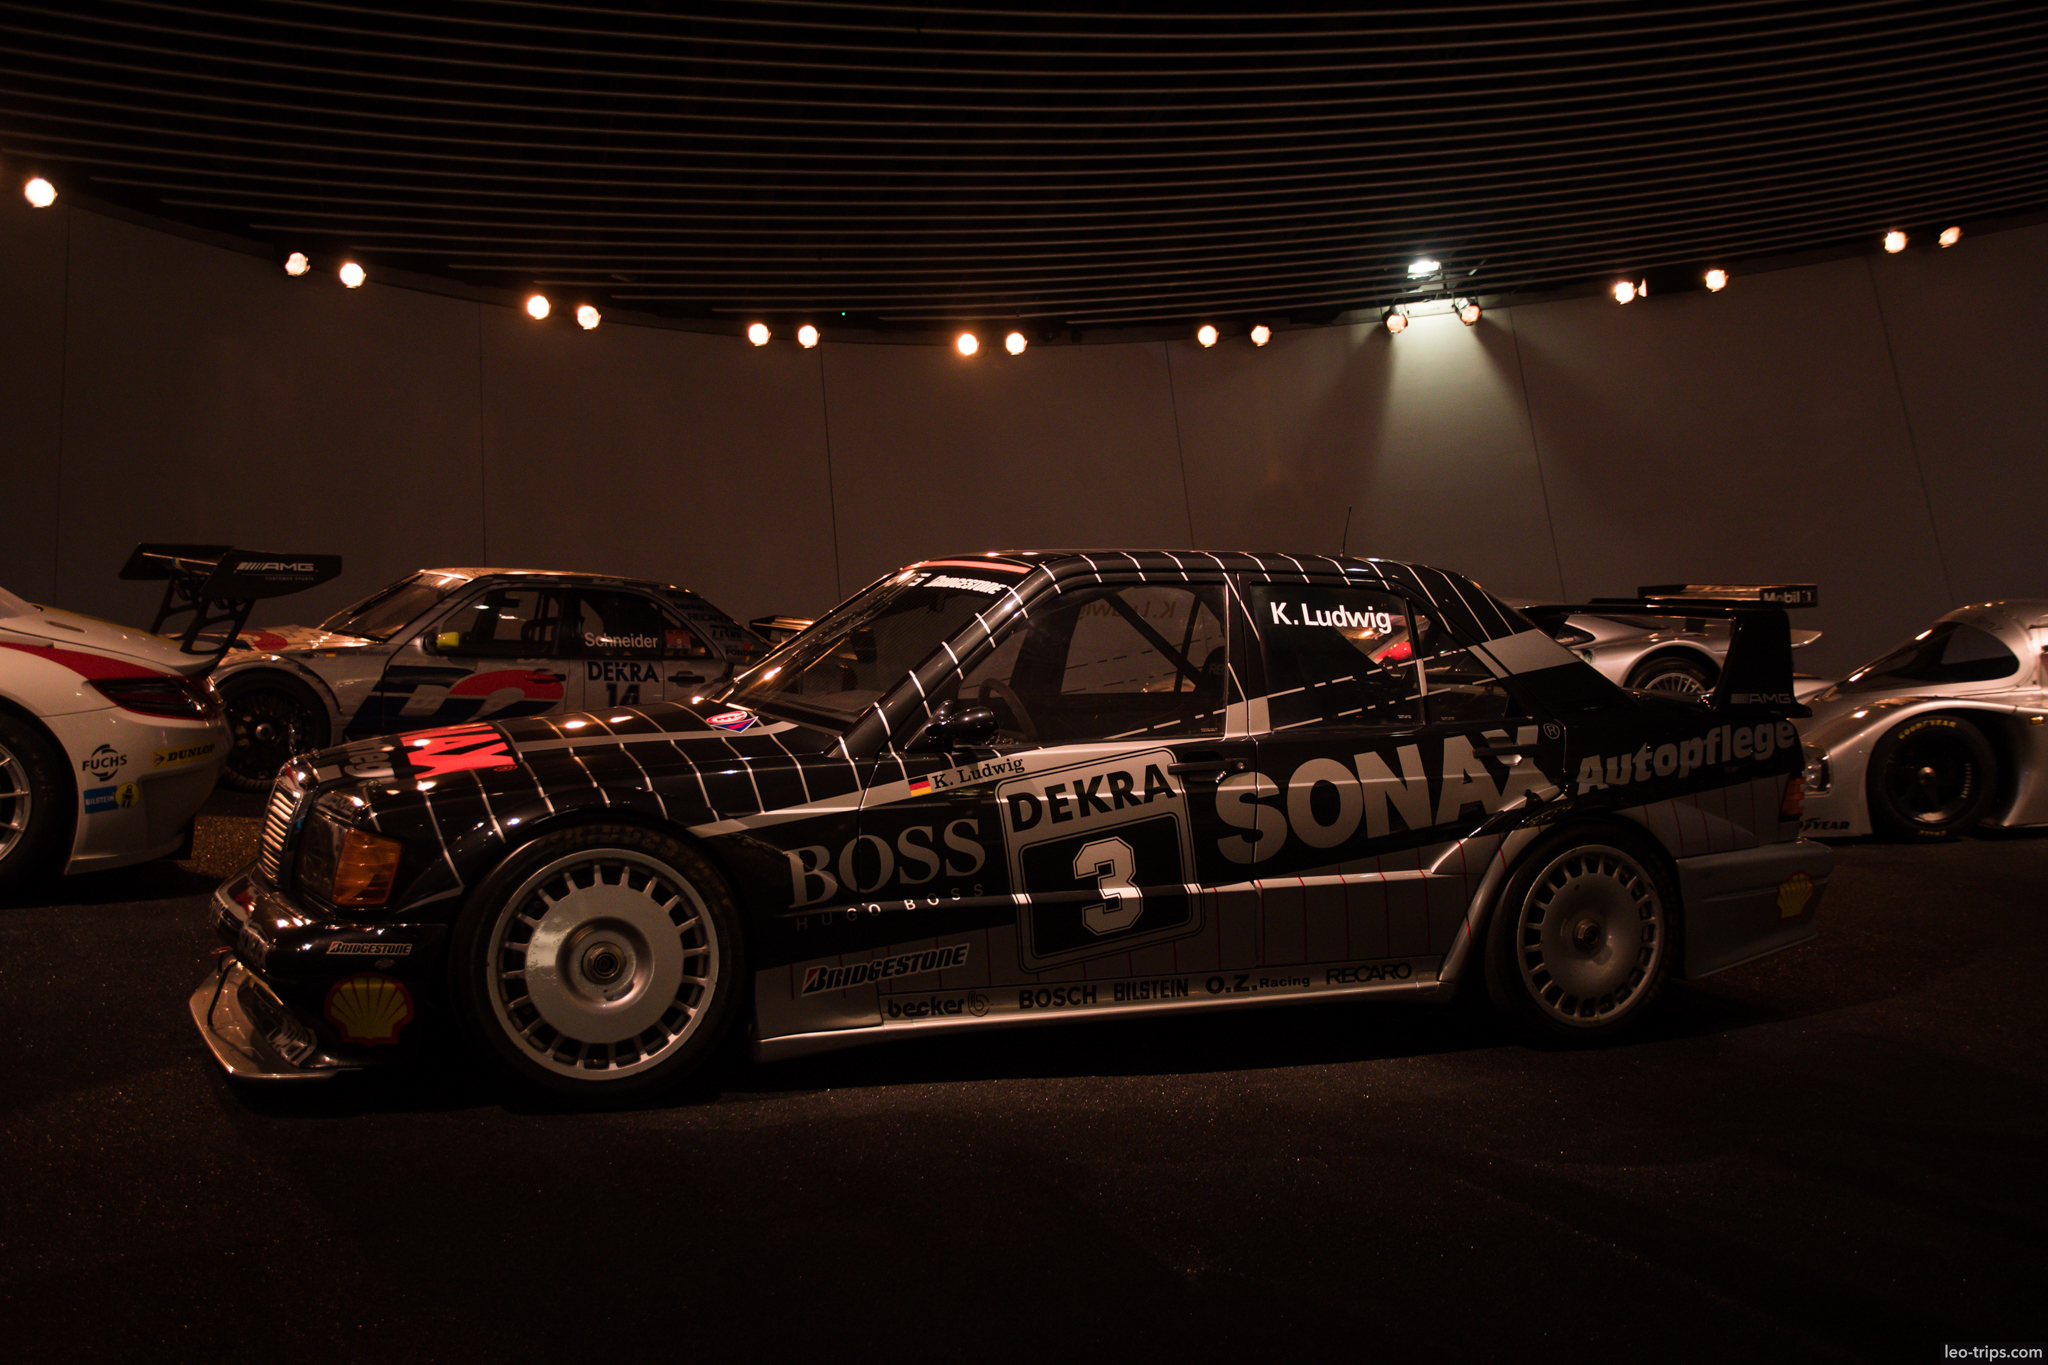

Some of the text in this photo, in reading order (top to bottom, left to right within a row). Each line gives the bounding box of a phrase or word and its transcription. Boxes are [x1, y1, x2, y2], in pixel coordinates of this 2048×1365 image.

[262, 563, 314, 572] AMG
[1763, 590, 1801, 603] Mobil
[1270, 601, 1393, 635] K. Ludwig
[584, 632, 658, 649] Schneider
[587, 661, 660, 682] DEKRA
[606, 683, 640, 707] 14
[1750, 693, 1792, 704] AMG
[82, 754, 128, 771] FUCHS
[167, 744, 215, 762] DUNLOP
[1576, 720, 1796, 796] Autopflege
[932, 758, 1025, 789] K. Ludwig
[1006, 764, 1177, 832] DEKRA
[1215, 724, 1560, 865] SONAX
[783, 818, 986, 909] BOSS
[1073, 836, 1143, 936] 3
[796, 883, 984, 932] HUGO BOSS
[328, 942, 411, 955] BRIDGESTONE
[802, 945, 968, 995] BRIDGESTONE
[1326, 962, 1412, 984] RECARO
[1114, 978, 1189, 1002] BILSTEIN
[1206, 974, 1311, 994] O.Z. Racing
[888, 996, 964, 1018] becker
[1020, 985, 1097, 1009] BOSCH
